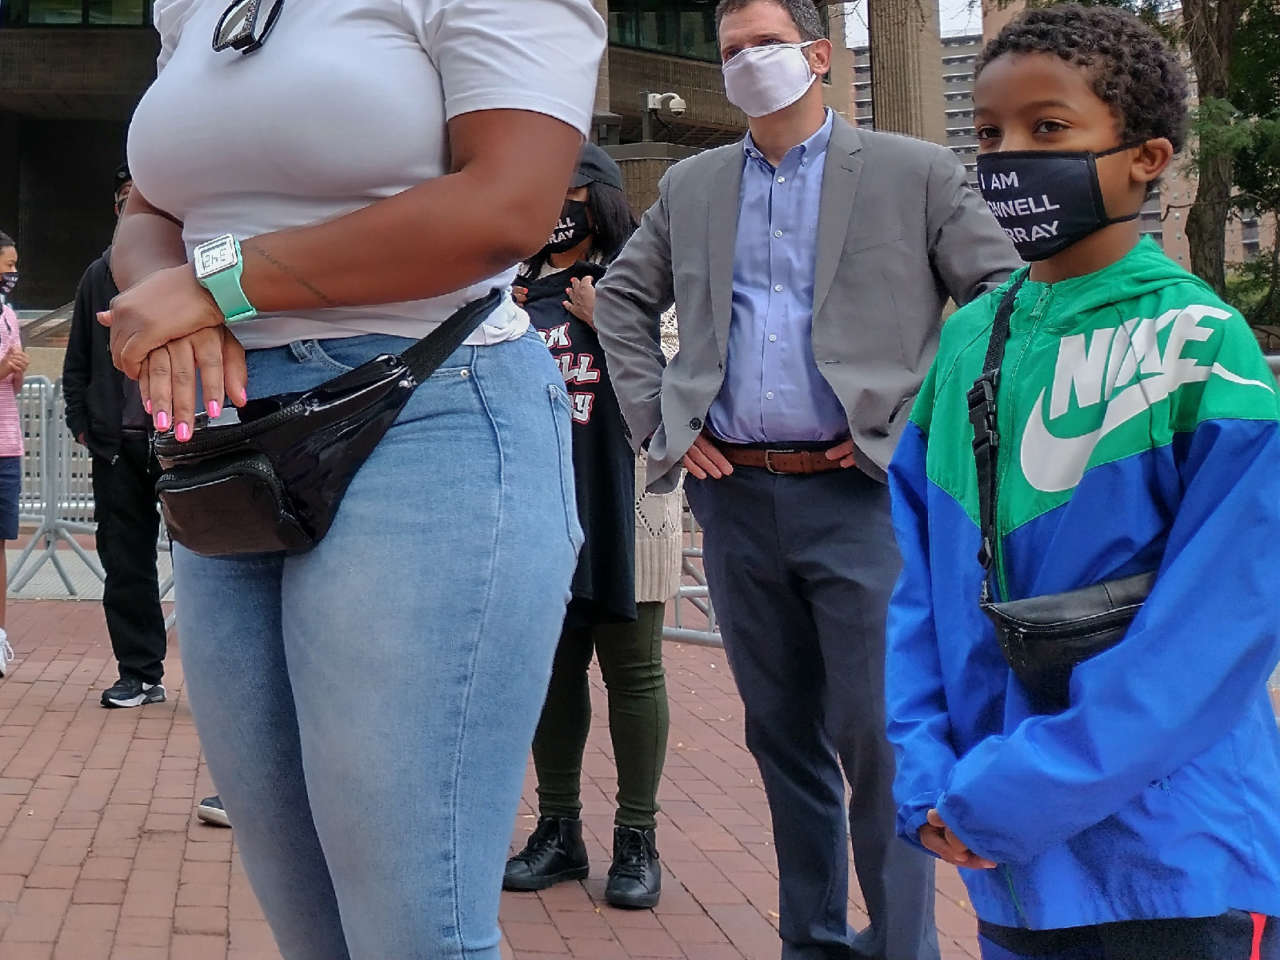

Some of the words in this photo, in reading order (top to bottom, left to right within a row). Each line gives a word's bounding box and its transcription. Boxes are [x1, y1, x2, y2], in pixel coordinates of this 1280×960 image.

[980, 173, 986, 190] I
[991, 171, 1019, 190] AM
[987, 194, 1060, 218] NNELL
[1004, 221, 1059, 243] RRAY
[1049, 304, 1232, 420] NIKE
